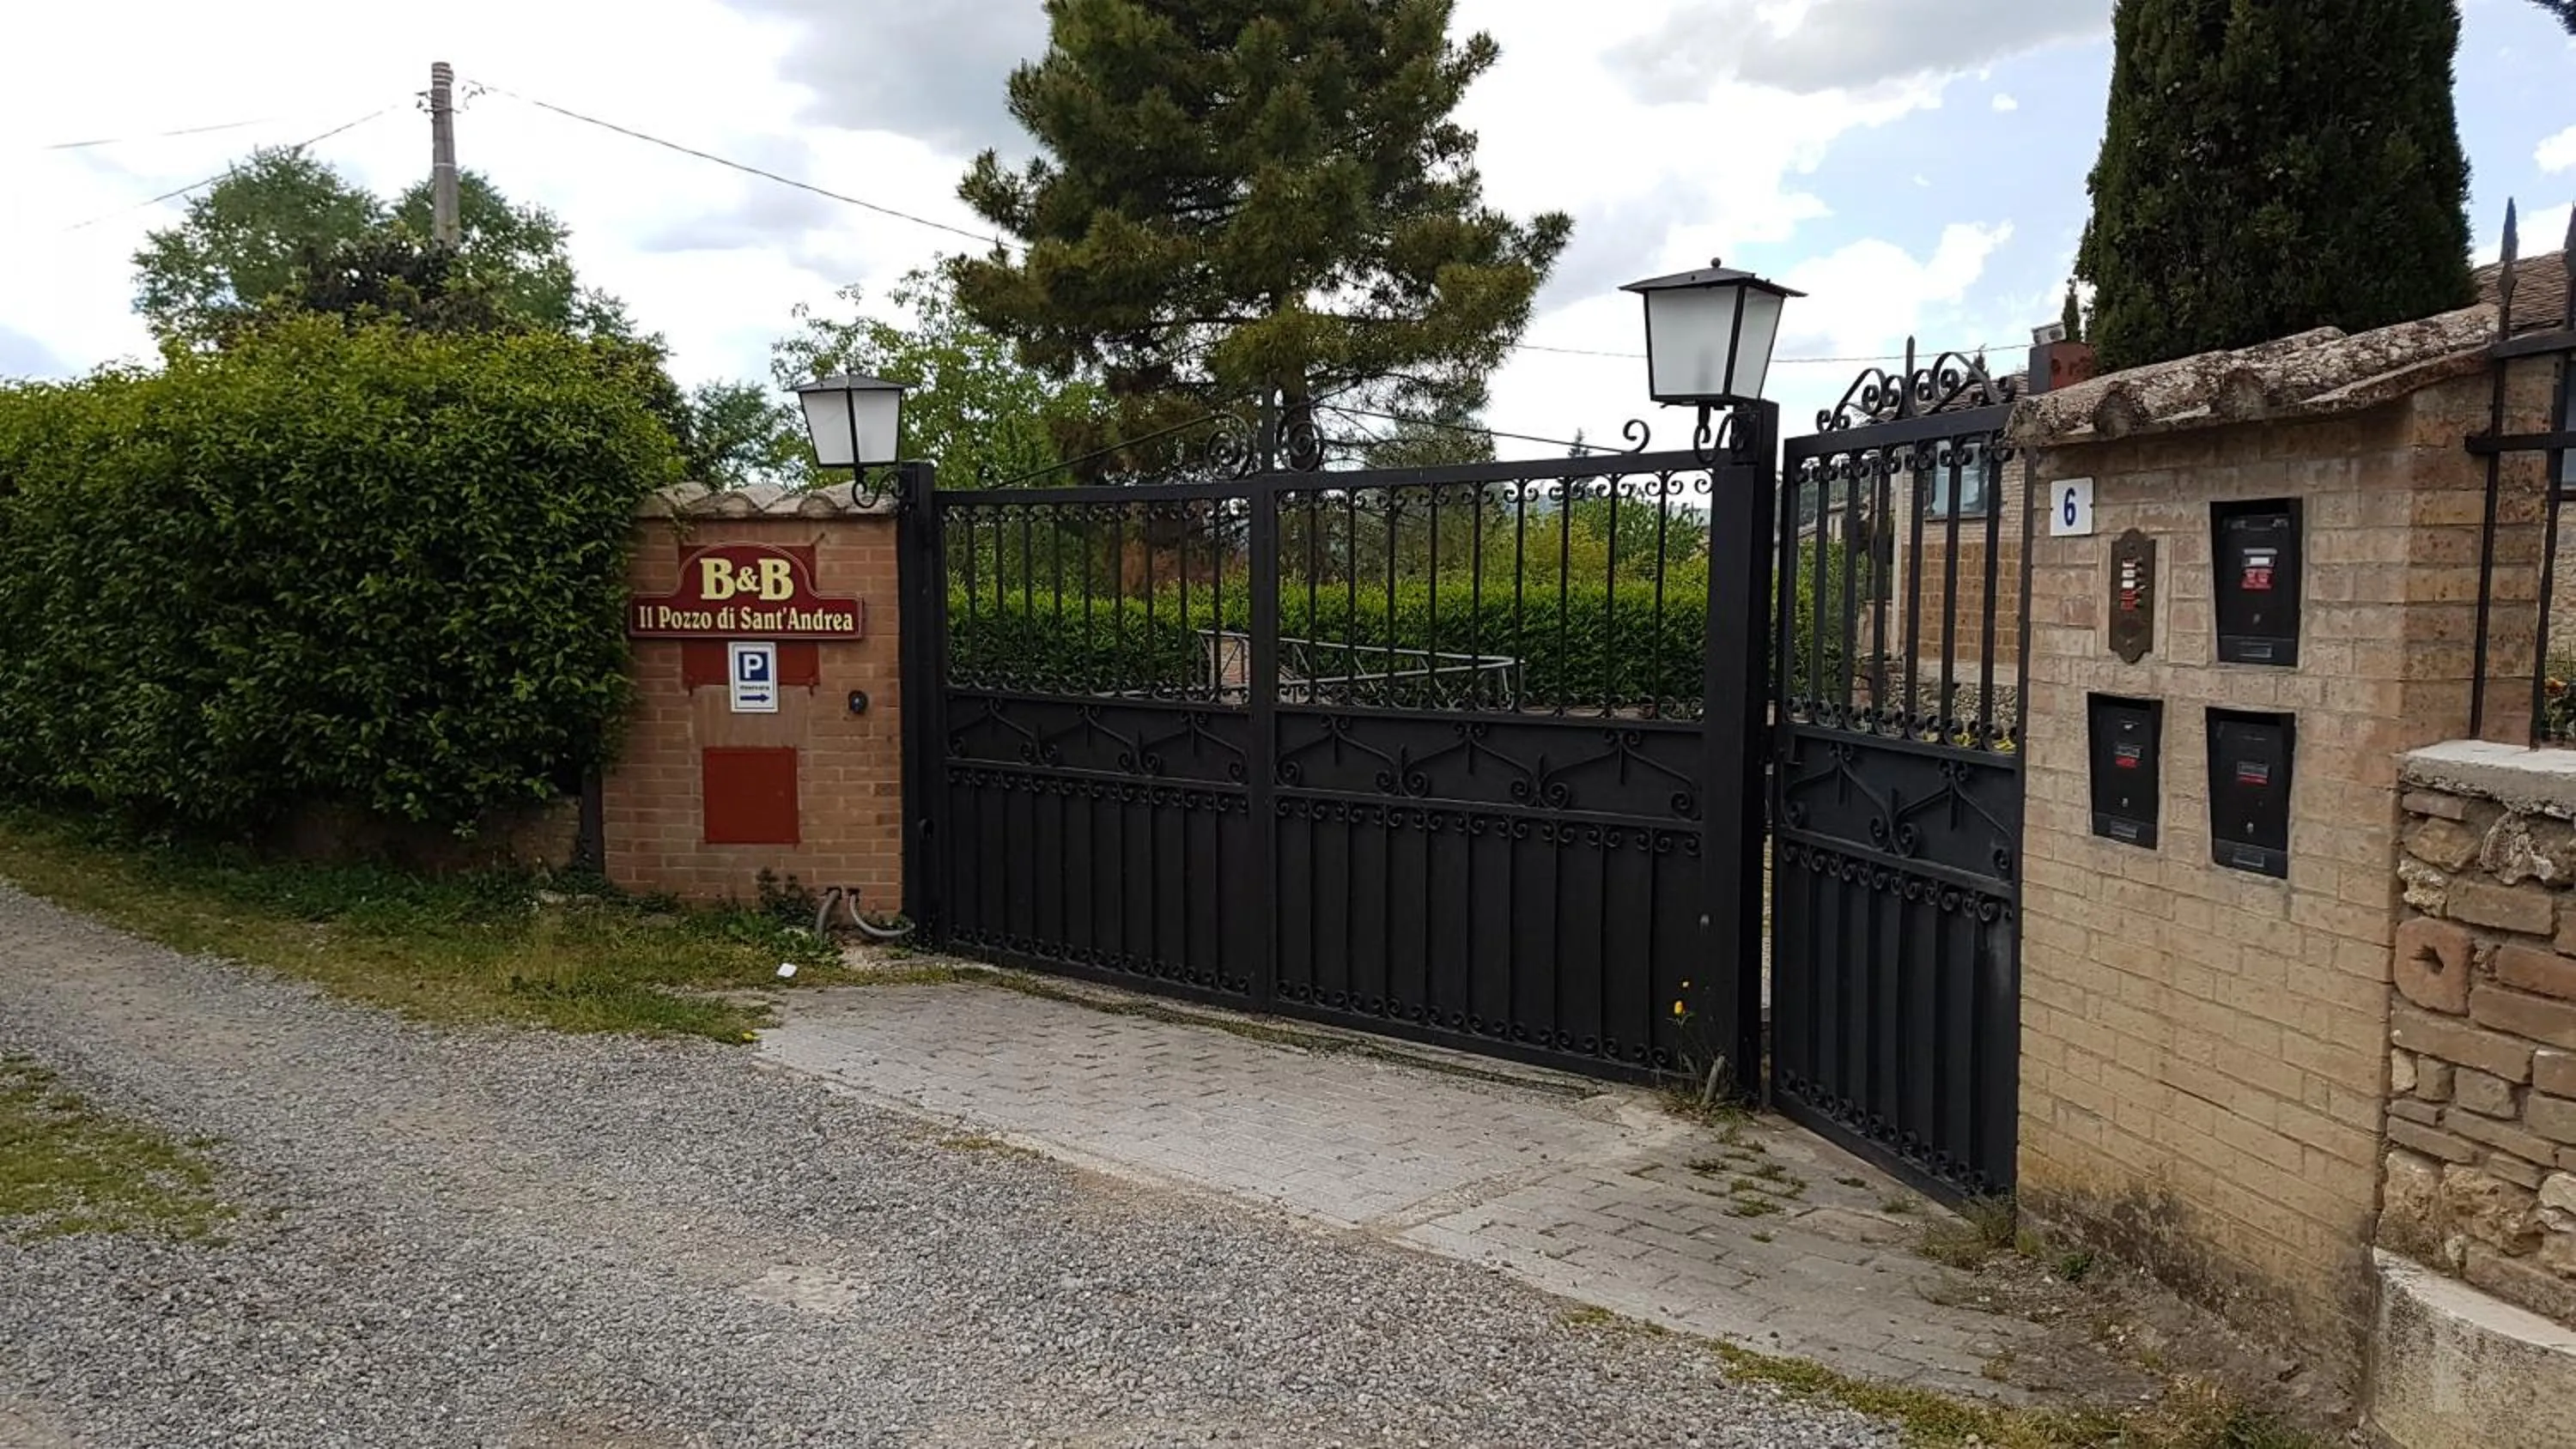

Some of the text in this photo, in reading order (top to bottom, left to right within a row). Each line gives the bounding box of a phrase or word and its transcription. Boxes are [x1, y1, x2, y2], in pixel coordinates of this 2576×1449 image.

[2063, 488, 2076, 525] 6
[701, 558, 793, 600] B&B
[639, 605, 854, 631] Il Pozzo di Sant'Andrea
[744, 654, 762, 679] P
